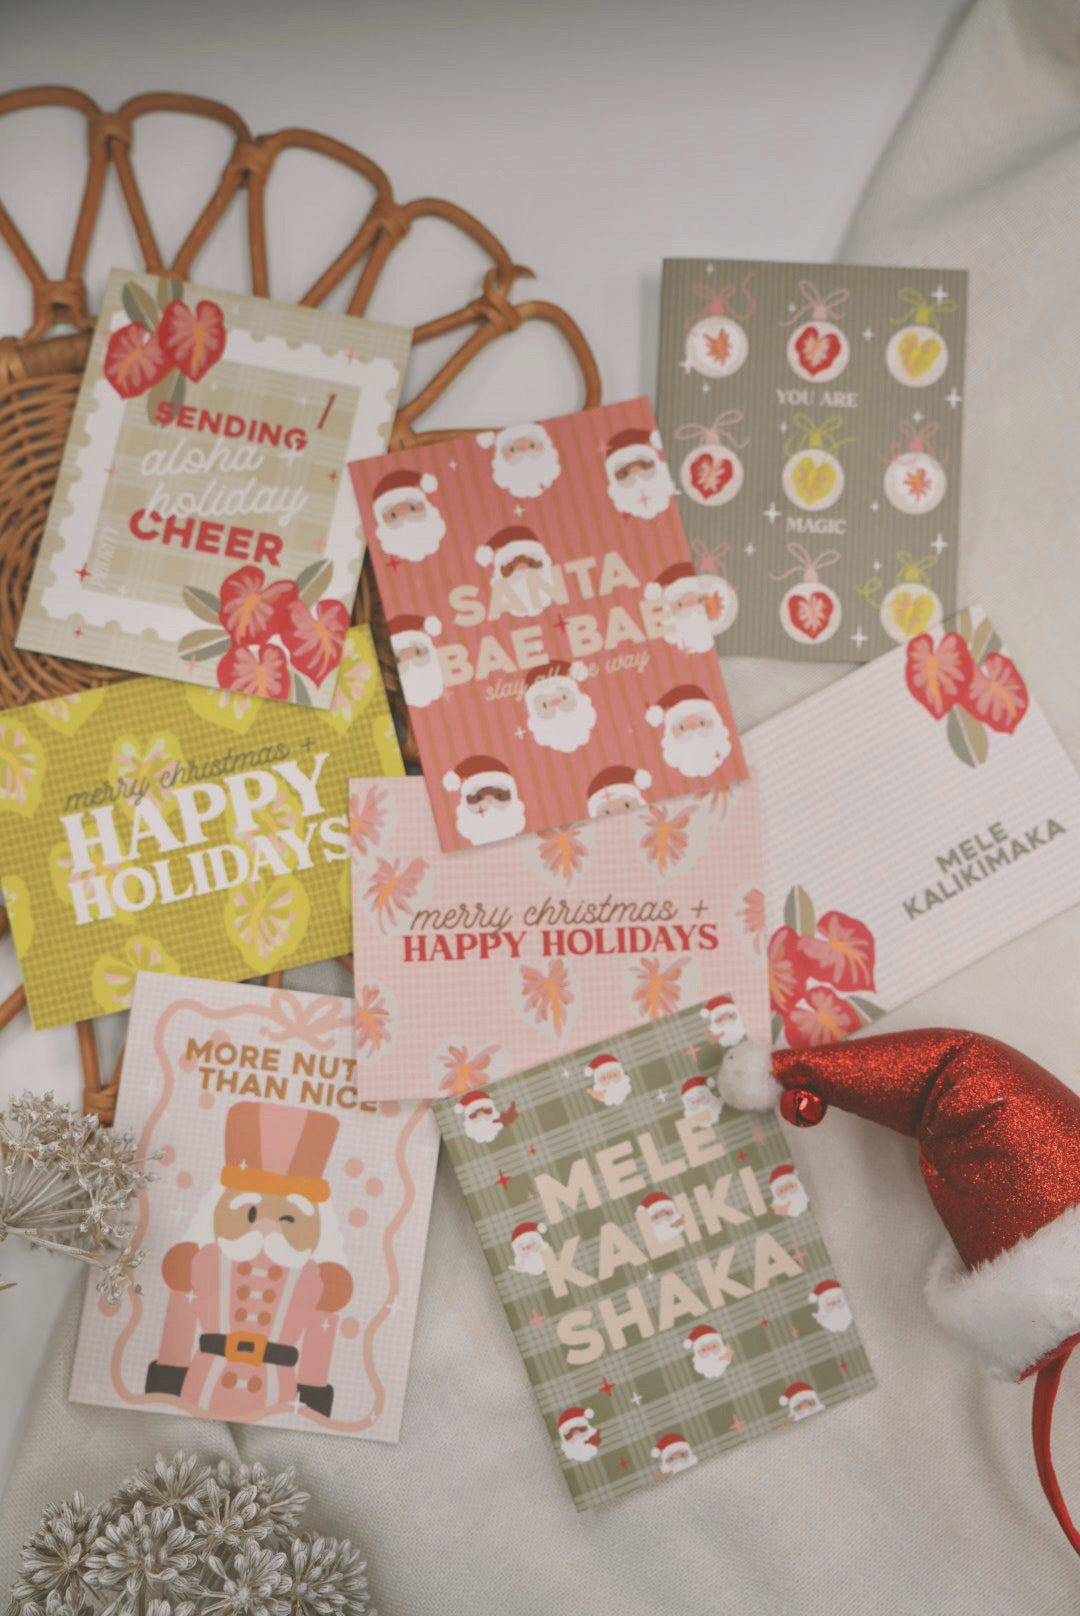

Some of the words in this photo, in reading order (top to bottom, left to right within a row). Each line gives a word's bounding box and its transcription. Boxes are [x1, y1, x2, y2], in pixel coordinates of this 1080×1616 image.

[776, 388, 815, 406] YOU
[820, 390, 859, 408] ARE
[155, 401, 308, 452] SENDING
[141, 437, 265, 476] aloha
[145, 477, 310, 527] holiday
[785, 516, 847, 535] MAGIC
[129, 508, 284, 567] CHEER
[448, 551, 641, 628] SANTA
[435, 625, 550, 688] BAE
[605, 651, 649, 674] way
[63, 776, 150, 812] merry
[160, 742, 290, 789] christmas
[59, 752, 331, 875] HAPPY
[67, 814, 351, 926] HOLIDAYS
[902, 818, 1067, 921] KALIKIMAKA
[935, 821, 1009, 875] MELE
[402, 930, 527, 962] HAPPY
[541, 923, 719, 957] HOLIDAYS
[409, 902, 513, 939] merry
[522, 894, 679, 927] christmas
[184, 1037, 282, 1073] MORE
[198, 1066, 289, 1101] THAN
[533, 1109, 726, 1225] MELE
[541, 1164, 768, 1299] KALIKI
[556, 1232, 804, 1366] SHAKA
